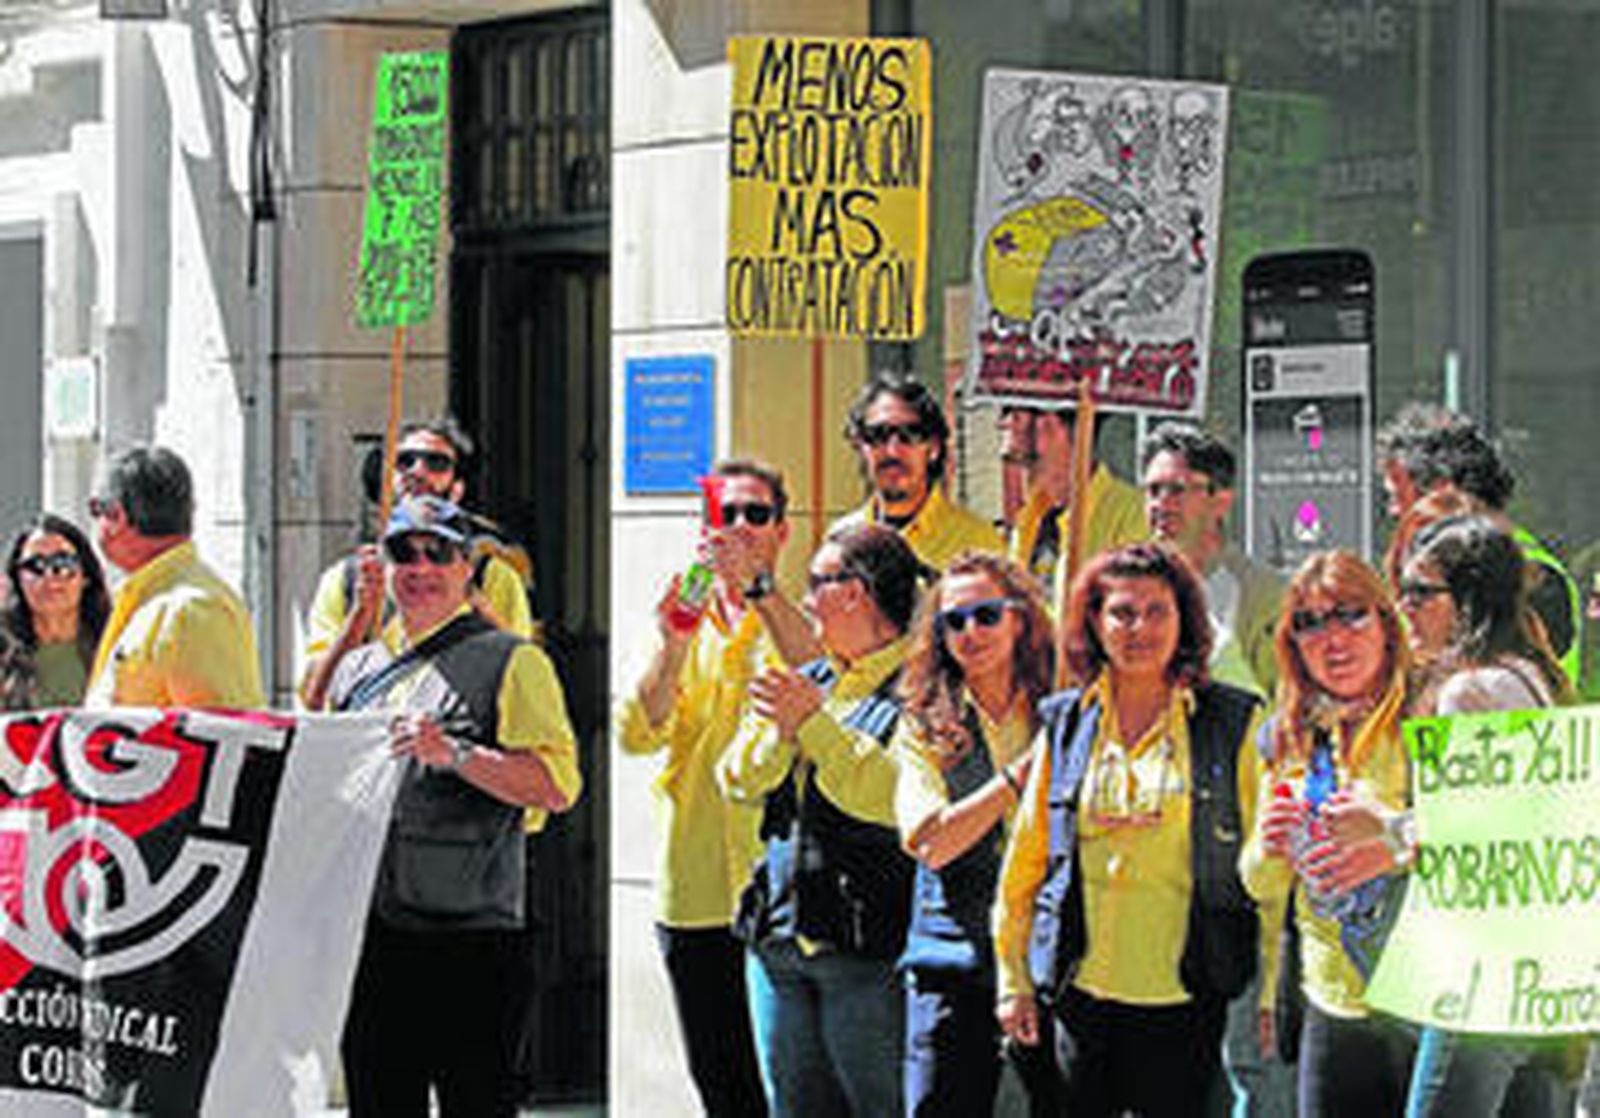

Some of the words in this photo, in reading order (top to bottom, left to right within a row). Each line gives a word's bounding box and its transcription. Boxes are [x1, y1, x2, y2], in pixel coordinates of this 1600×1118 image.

[753, 39, 910, 112] MENOS
[772, 190, 882, 260] MAS
[1415, 724, 1513, 793] Basta
